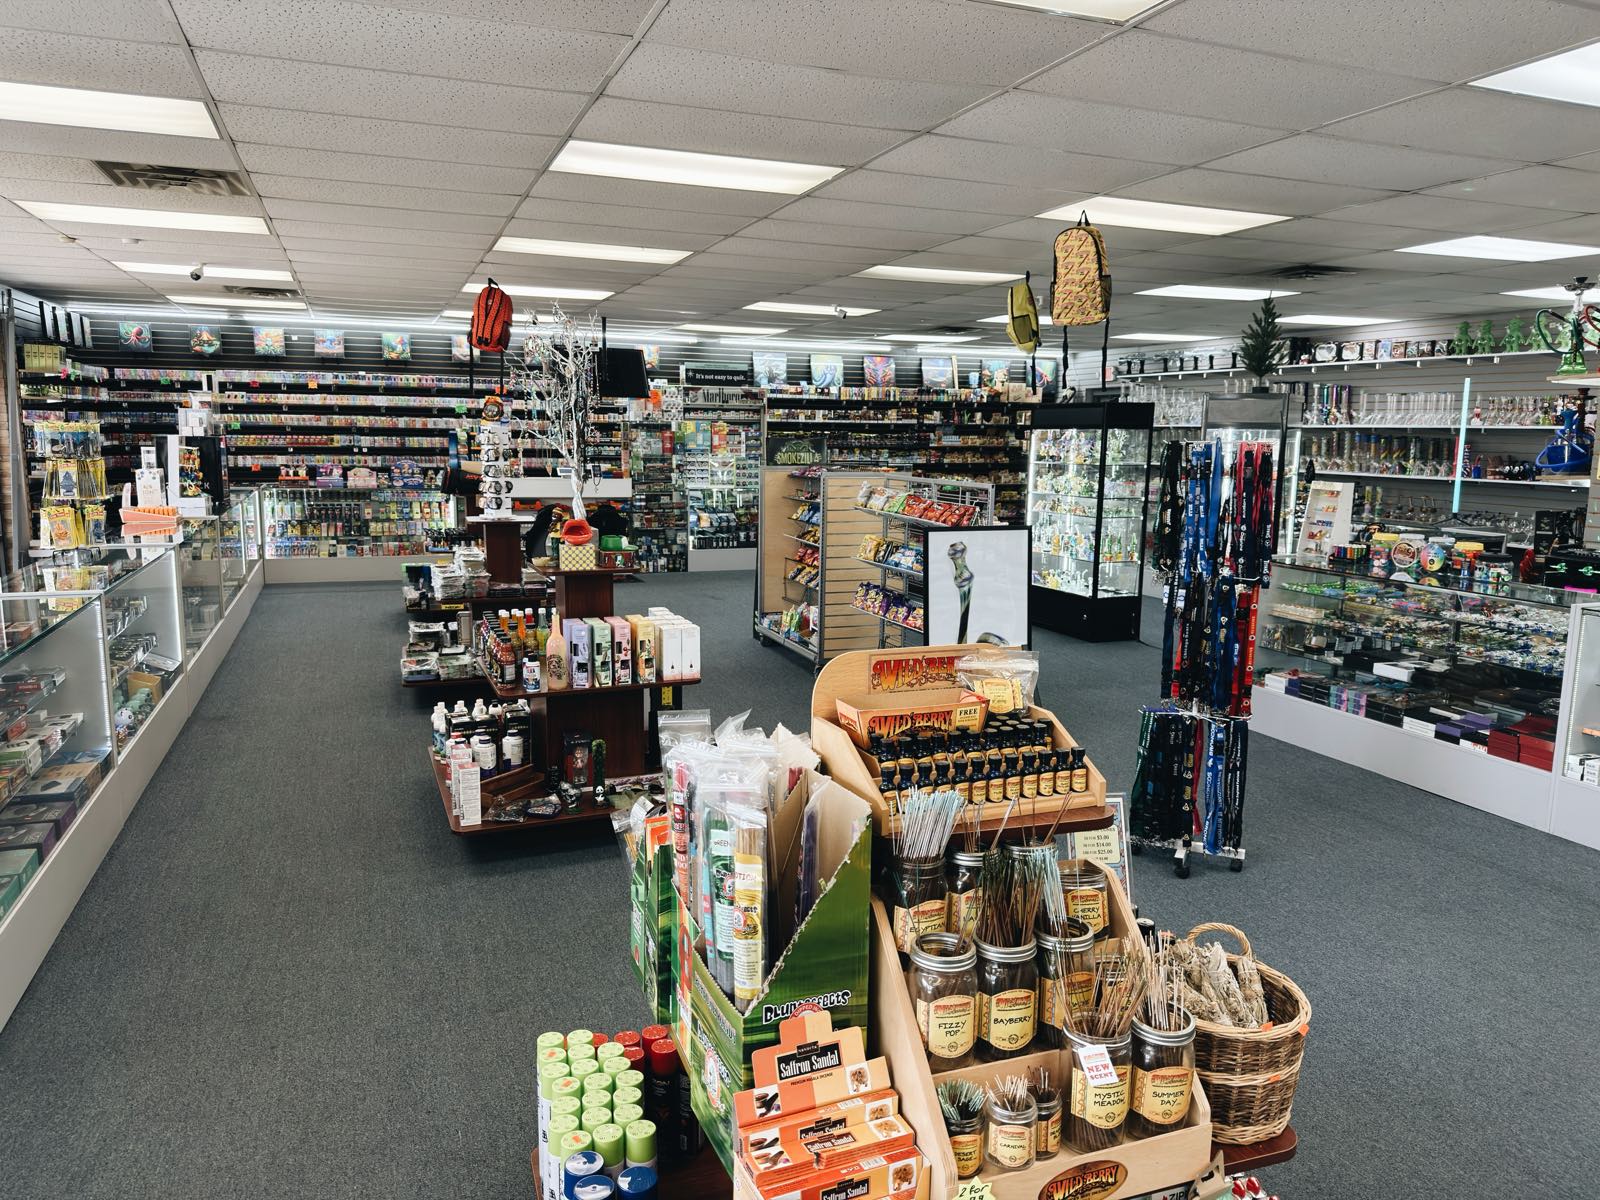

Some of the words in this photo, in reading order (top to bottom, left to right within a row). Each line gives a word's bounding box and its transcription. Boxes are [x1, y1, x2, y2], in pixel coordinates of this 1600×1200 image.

[702, 387, 742, 405] Marlboro
[872, 657, 923, 691] WILD
[959, 707, 978, 717] FREE
[869, 714, 912, 739] WILD
[913, 710, 953, 733] BERRY
[1073, 907, 1100, 915] CHERRY
[938, 1020, 967, 1030] FIZZY
[993, 1014, 1033, 1027] BAYBERRY
[945, 1029, 961, 1037] POP
[780, 1059, 811, 1078] Saffron
[811, 1049, 840, 1070] Sandal
[1087, 1063, 1110, 1074] NEW
[1089, 1071, 1114, 1080] SCENT
[1094, 1089, 1125, 1100] MYSTIC
[1152, 1090, 1185, 1099] SUMMER
[1160, 1098, 1178, 1107] DAY
[832, 1135, 855, 1147] Sandal
[1000, 1142, 1027, 1150] CARNIVAL
[1047, 1175, 1083, 1200] WILD
[1083, 1165, 1119, 1184] BERRY
[847, 1183, 868, 1197] Sandal
[959, 1187, 967, 1198] 2
[969, 1185, 989, 1194] for
